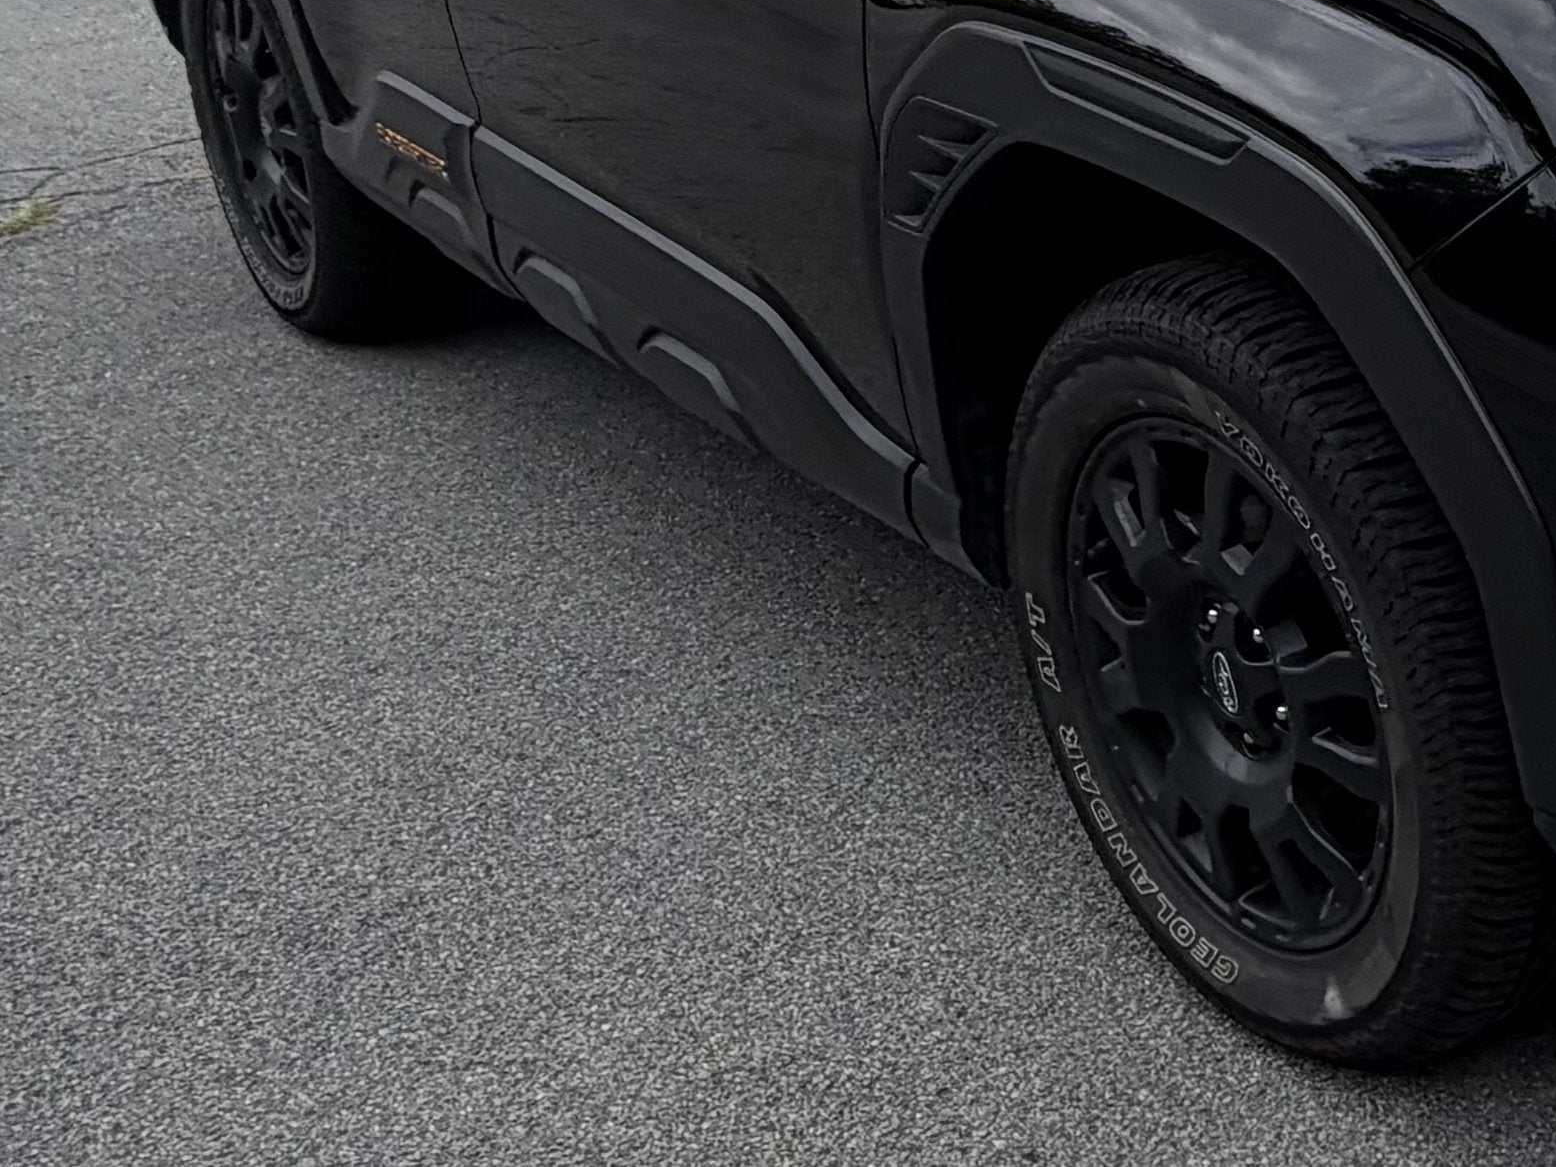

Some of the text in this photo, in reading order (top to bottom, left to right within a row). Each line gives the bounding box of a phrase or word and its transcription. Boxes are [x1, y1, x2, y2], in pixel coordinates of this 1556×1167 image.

[1214, 410, 1388, 709] YOKOHAMA
[1024, 592, 1240, 985] GEOLANDAR A/T
